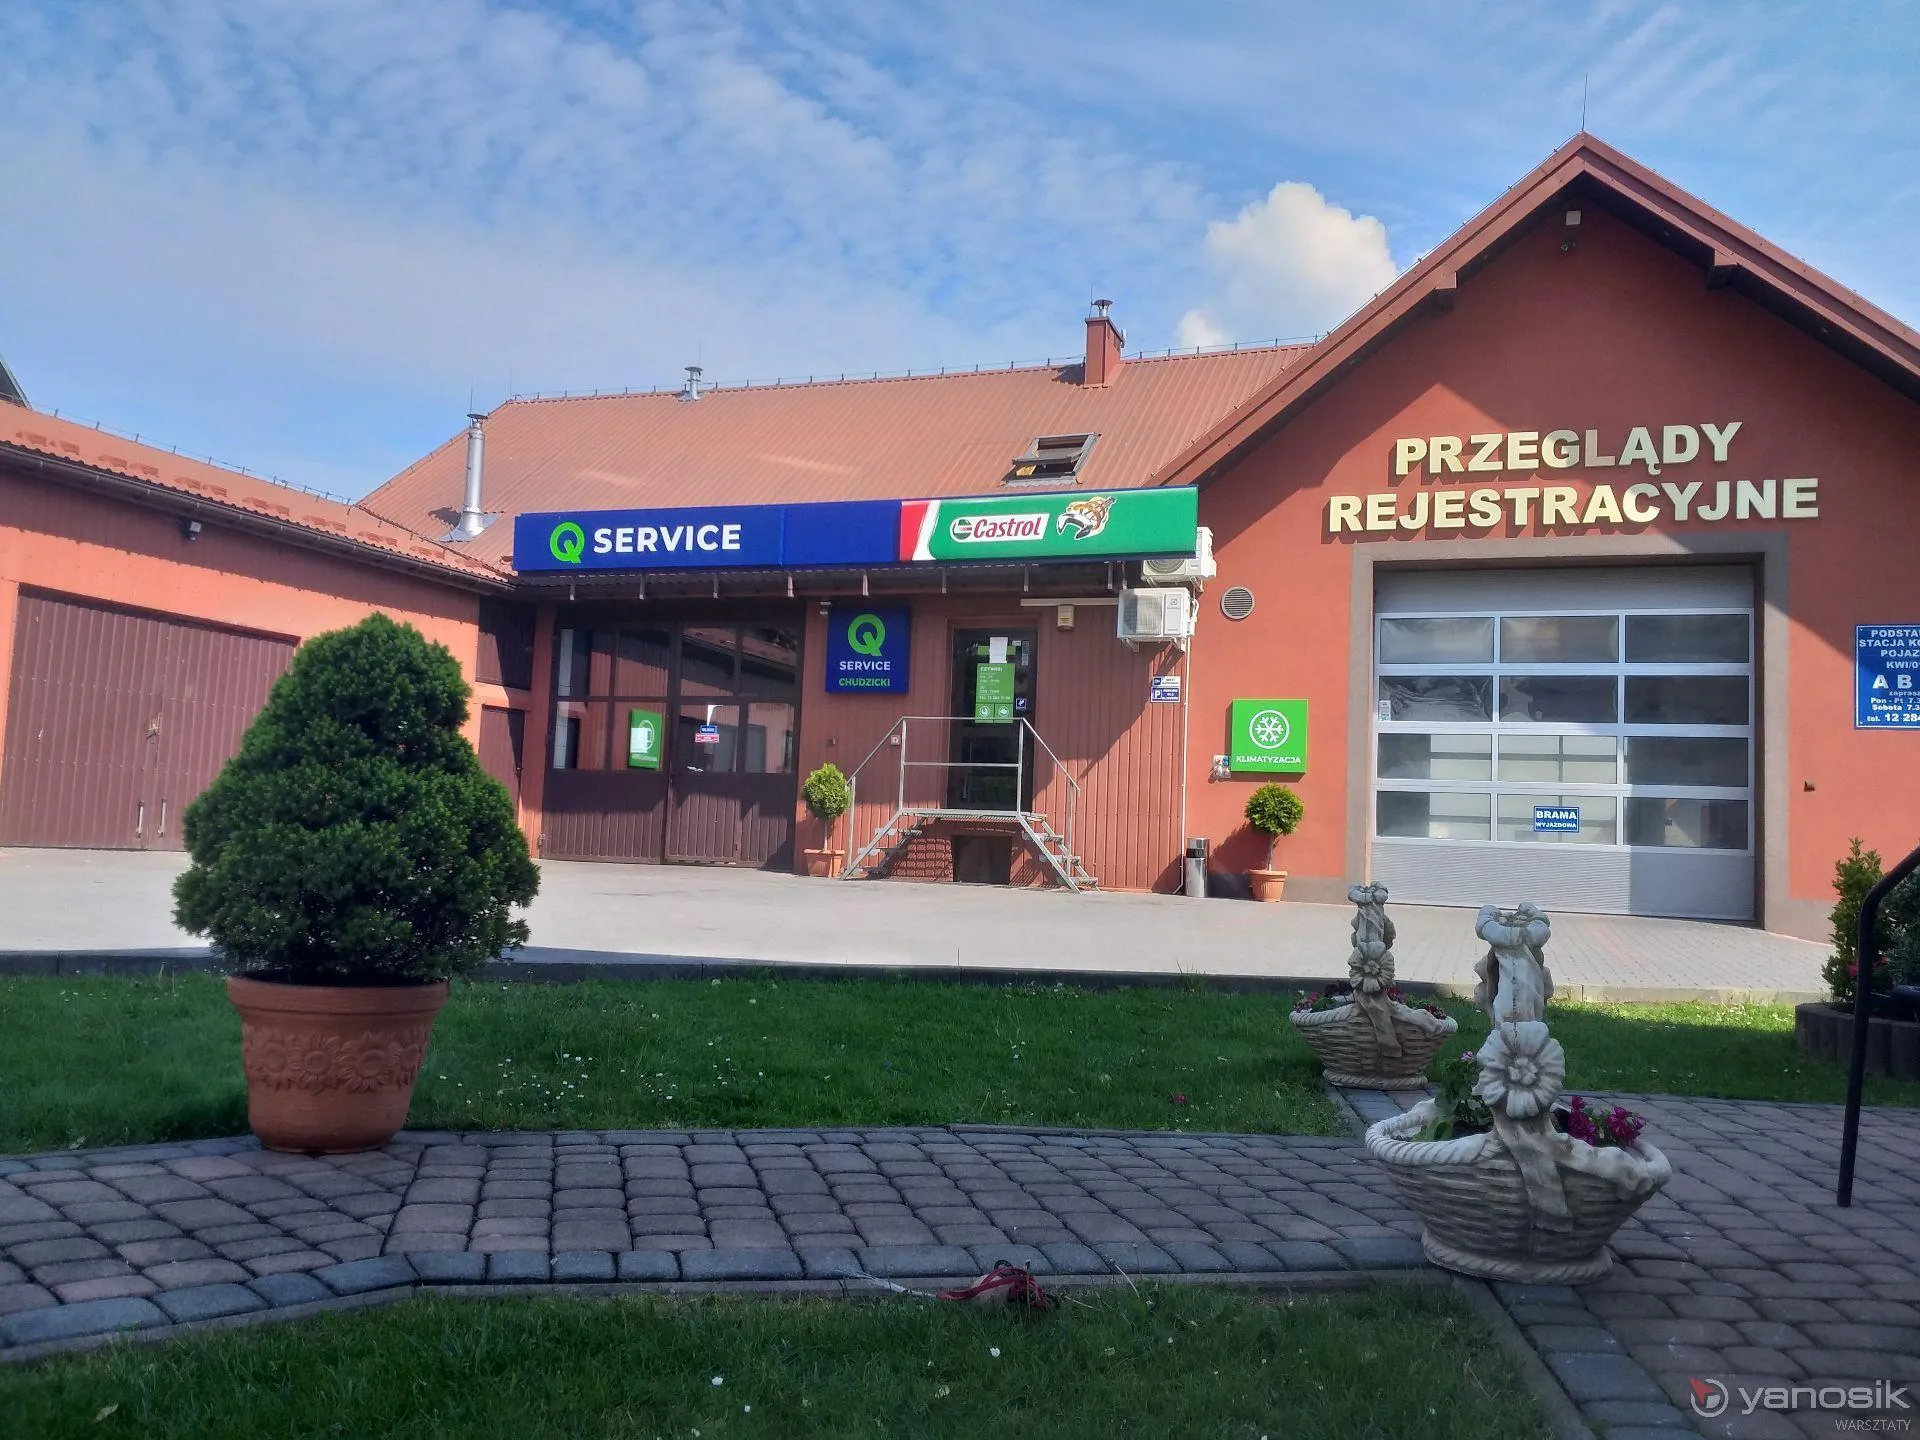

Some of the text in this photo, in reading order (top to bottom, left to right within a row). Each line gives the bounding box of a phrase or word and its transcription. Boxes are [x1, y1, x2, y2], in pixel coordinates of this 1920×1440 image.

[1395, 421, 1743, 476] PRZEGLĄDY
[1329, 477, 1820, 533] REJESTRACYJNE
[973, 516, 1042, 539] Castrol
[593, 524, 742, 554] SERVICE
[1871, 629, 1920, 638] PODSTA
[1859, 638, 1905, 648] STACJA
[839, 660, 891, 671] SERVICE
[1886, 661, 1920, 669] KWI/0
[838, 677, 891, 687] CHUDZICKI
[1872, 674, 1912, 689] A B
[1885, 713, 1899, 722] 12
[1236, 755, 1302, 764] KLIMATYZACJA
[1536, 810, 1577, 820] BRAMA
